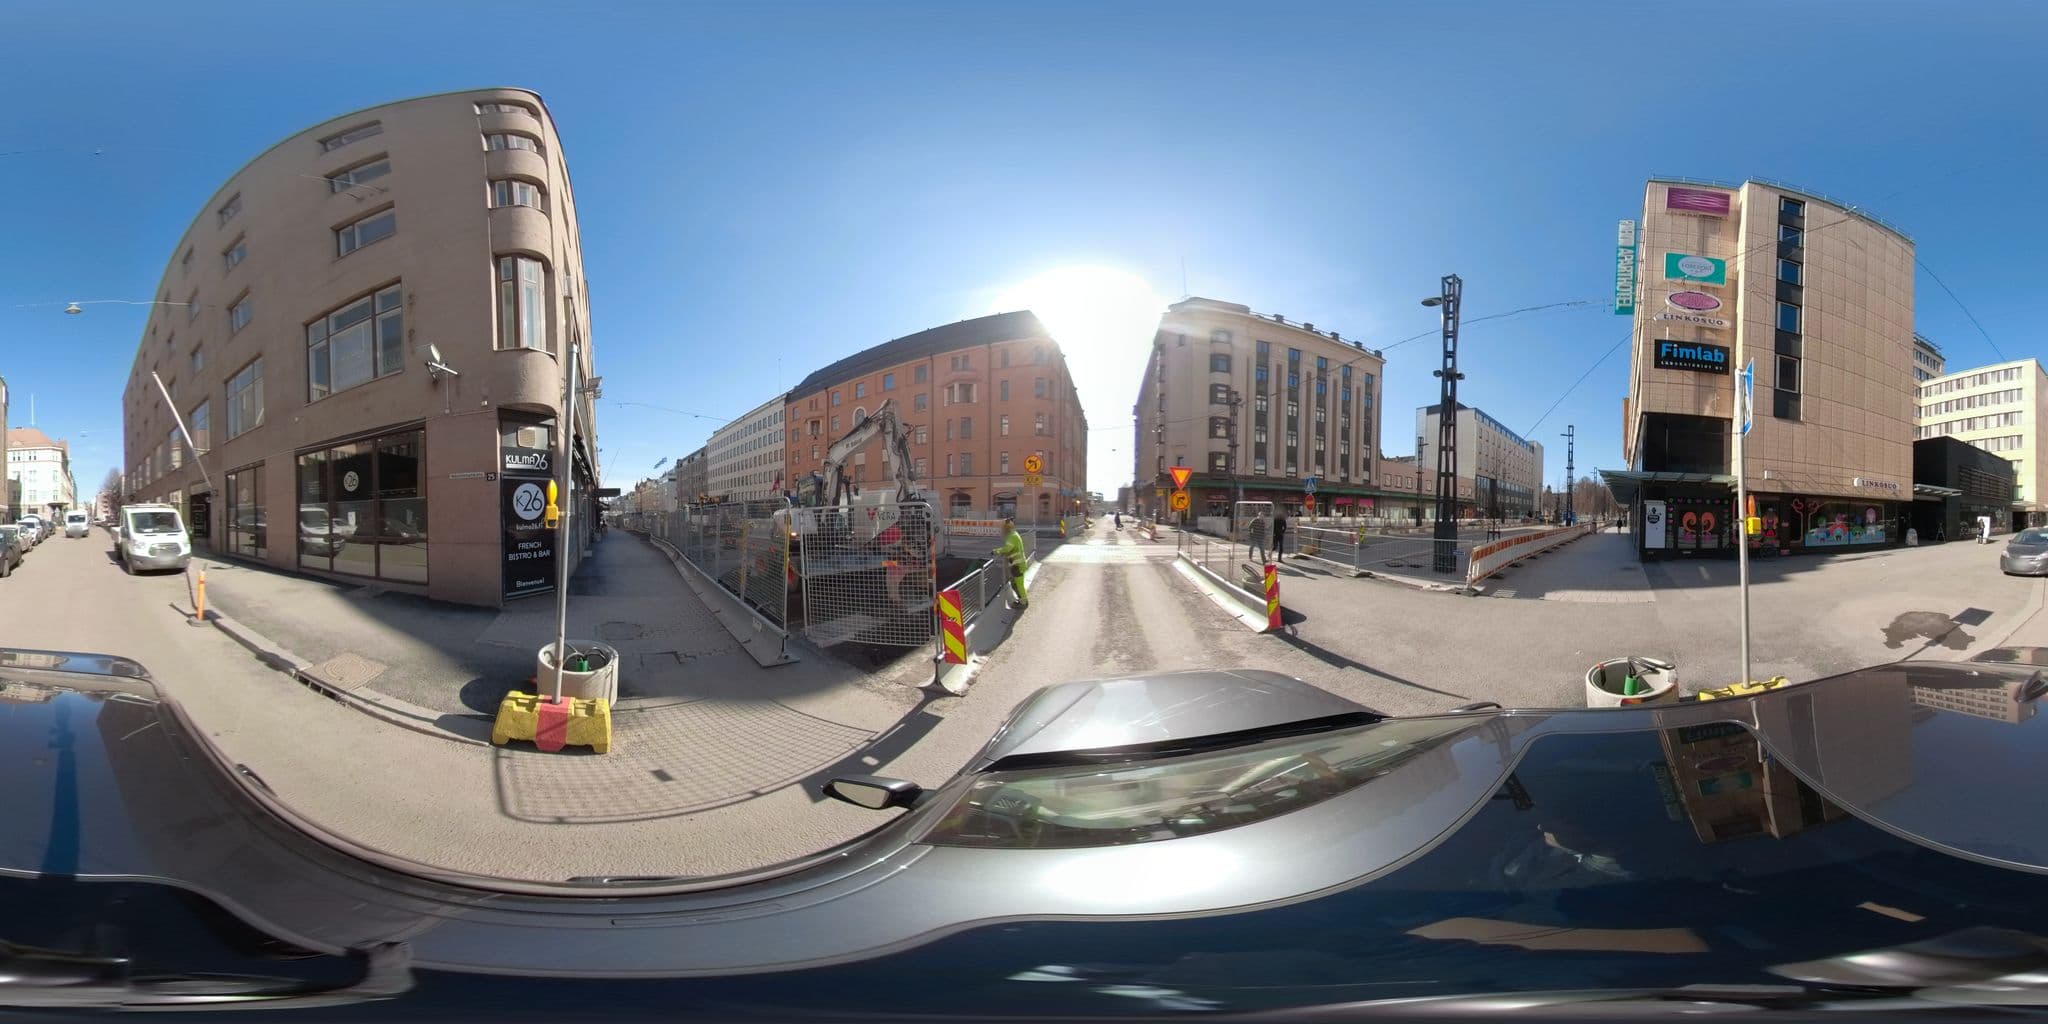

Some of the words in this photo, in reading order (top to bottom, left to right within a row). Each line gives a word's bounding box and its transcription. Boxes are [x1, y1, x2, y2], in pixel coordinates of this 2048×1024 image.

[1663, 313, 1724, 326] LINKOSUO
[1661, 343, 1725, 363] Fimlab
[1862, 480, 1897, 490] LINKOSUO
[516, 490, 543, 511] K26
[518, 541, 542, 550] FRENCH
[508, 552, 532, 560] BISTRO
[538, 549, 551, 558] BAR
